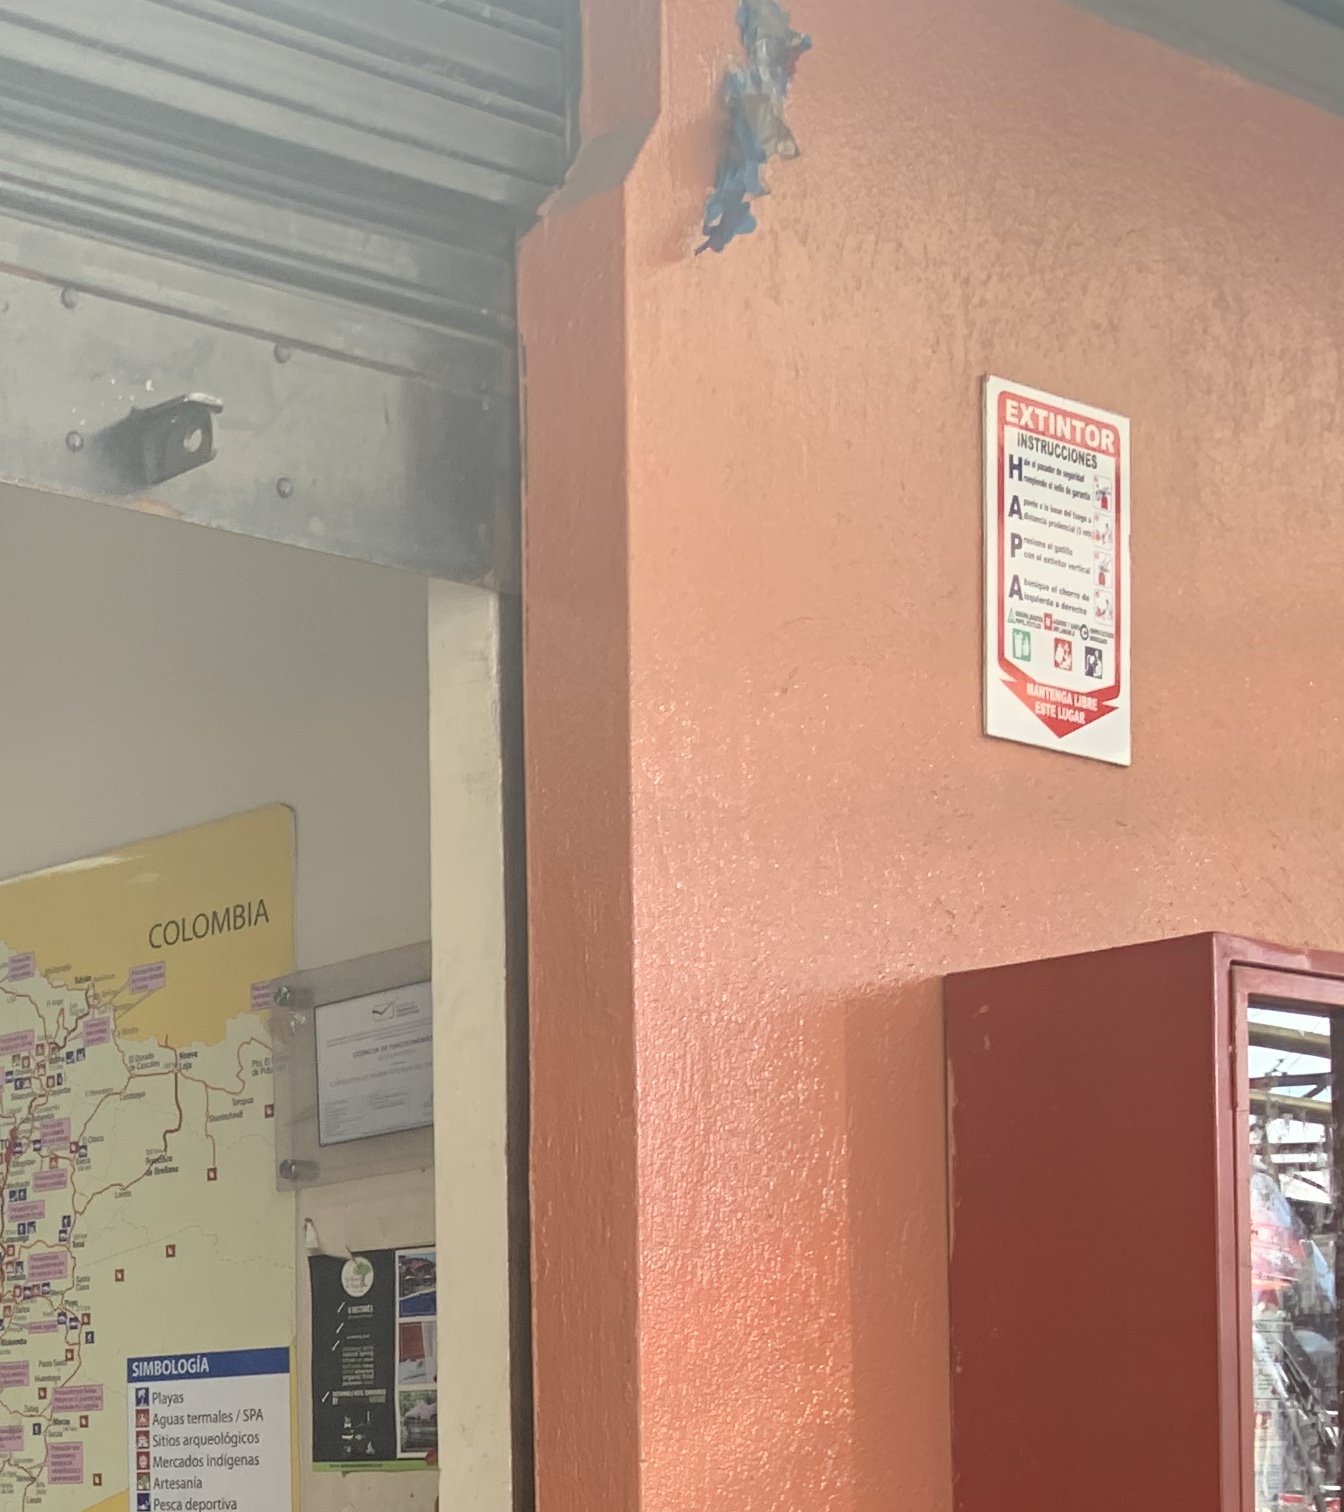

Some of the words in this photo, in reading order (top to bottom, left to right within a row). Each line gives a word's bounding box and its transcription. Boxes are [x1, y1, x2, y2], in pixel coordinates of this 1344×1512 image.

[1005, 399, 1115, 453] EXTINTOR
[1017, 432, 1098, 469] INSTRUCCIONES
[1026, 683, 1073, 706] MANTENGA
[1074, 694, 1098, 711] LIBRE
[1035, 702, 1057, 717] ESTE
[1057, 707, 1086, 724] LUGAR
[148, 899, 270, 949] COLOMBIA
[132, 1356, 209, 1376] SIMBOLOGÍA
[152, 1392, 184, 1407] Playas
[152, 1413, 184, 1428] Aguas
[187, 1410, 233, 1424] termales
[243, 1409, 264, 1422] SPA
[153, 1434, 180, 1447] Sitios
[183, 1432, 260, 1449] arqueológicos
[153, 1455, 204, 1468] Mercados
[206, 1453, 260, 1469] indígenas
[153, 1476, 202, 1490] Artesanía
[153, 1499, 182, 1511] Pesca
[185, 1498, 237, 1512] deportiva
